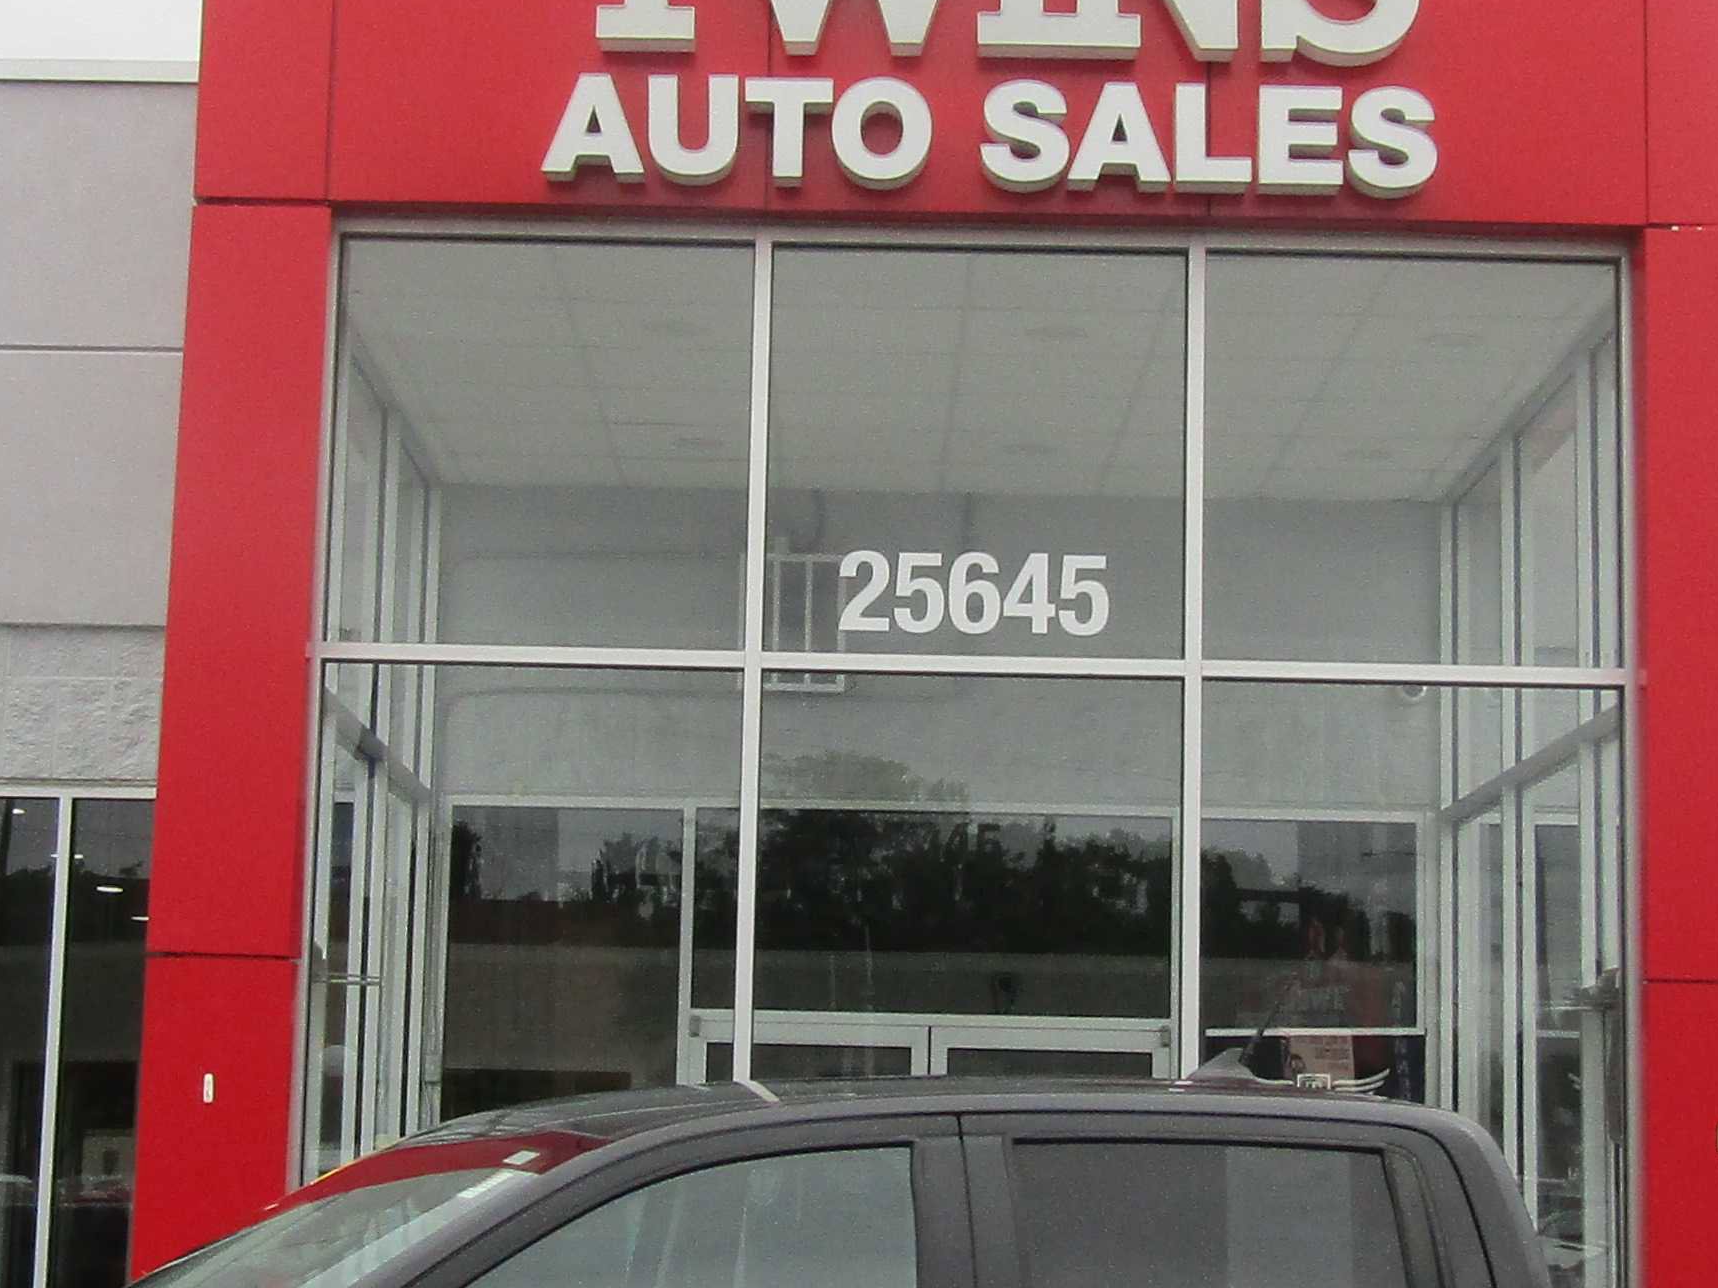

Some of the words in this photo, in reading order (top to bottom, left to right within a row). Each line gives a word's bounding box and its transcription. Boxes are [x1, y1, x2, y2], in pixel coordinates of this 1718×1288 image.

[540, 73, 933, 191] AUTO
[980, 78, 1439, 199] SALES
[838, 550, 1110, 636] 25645
